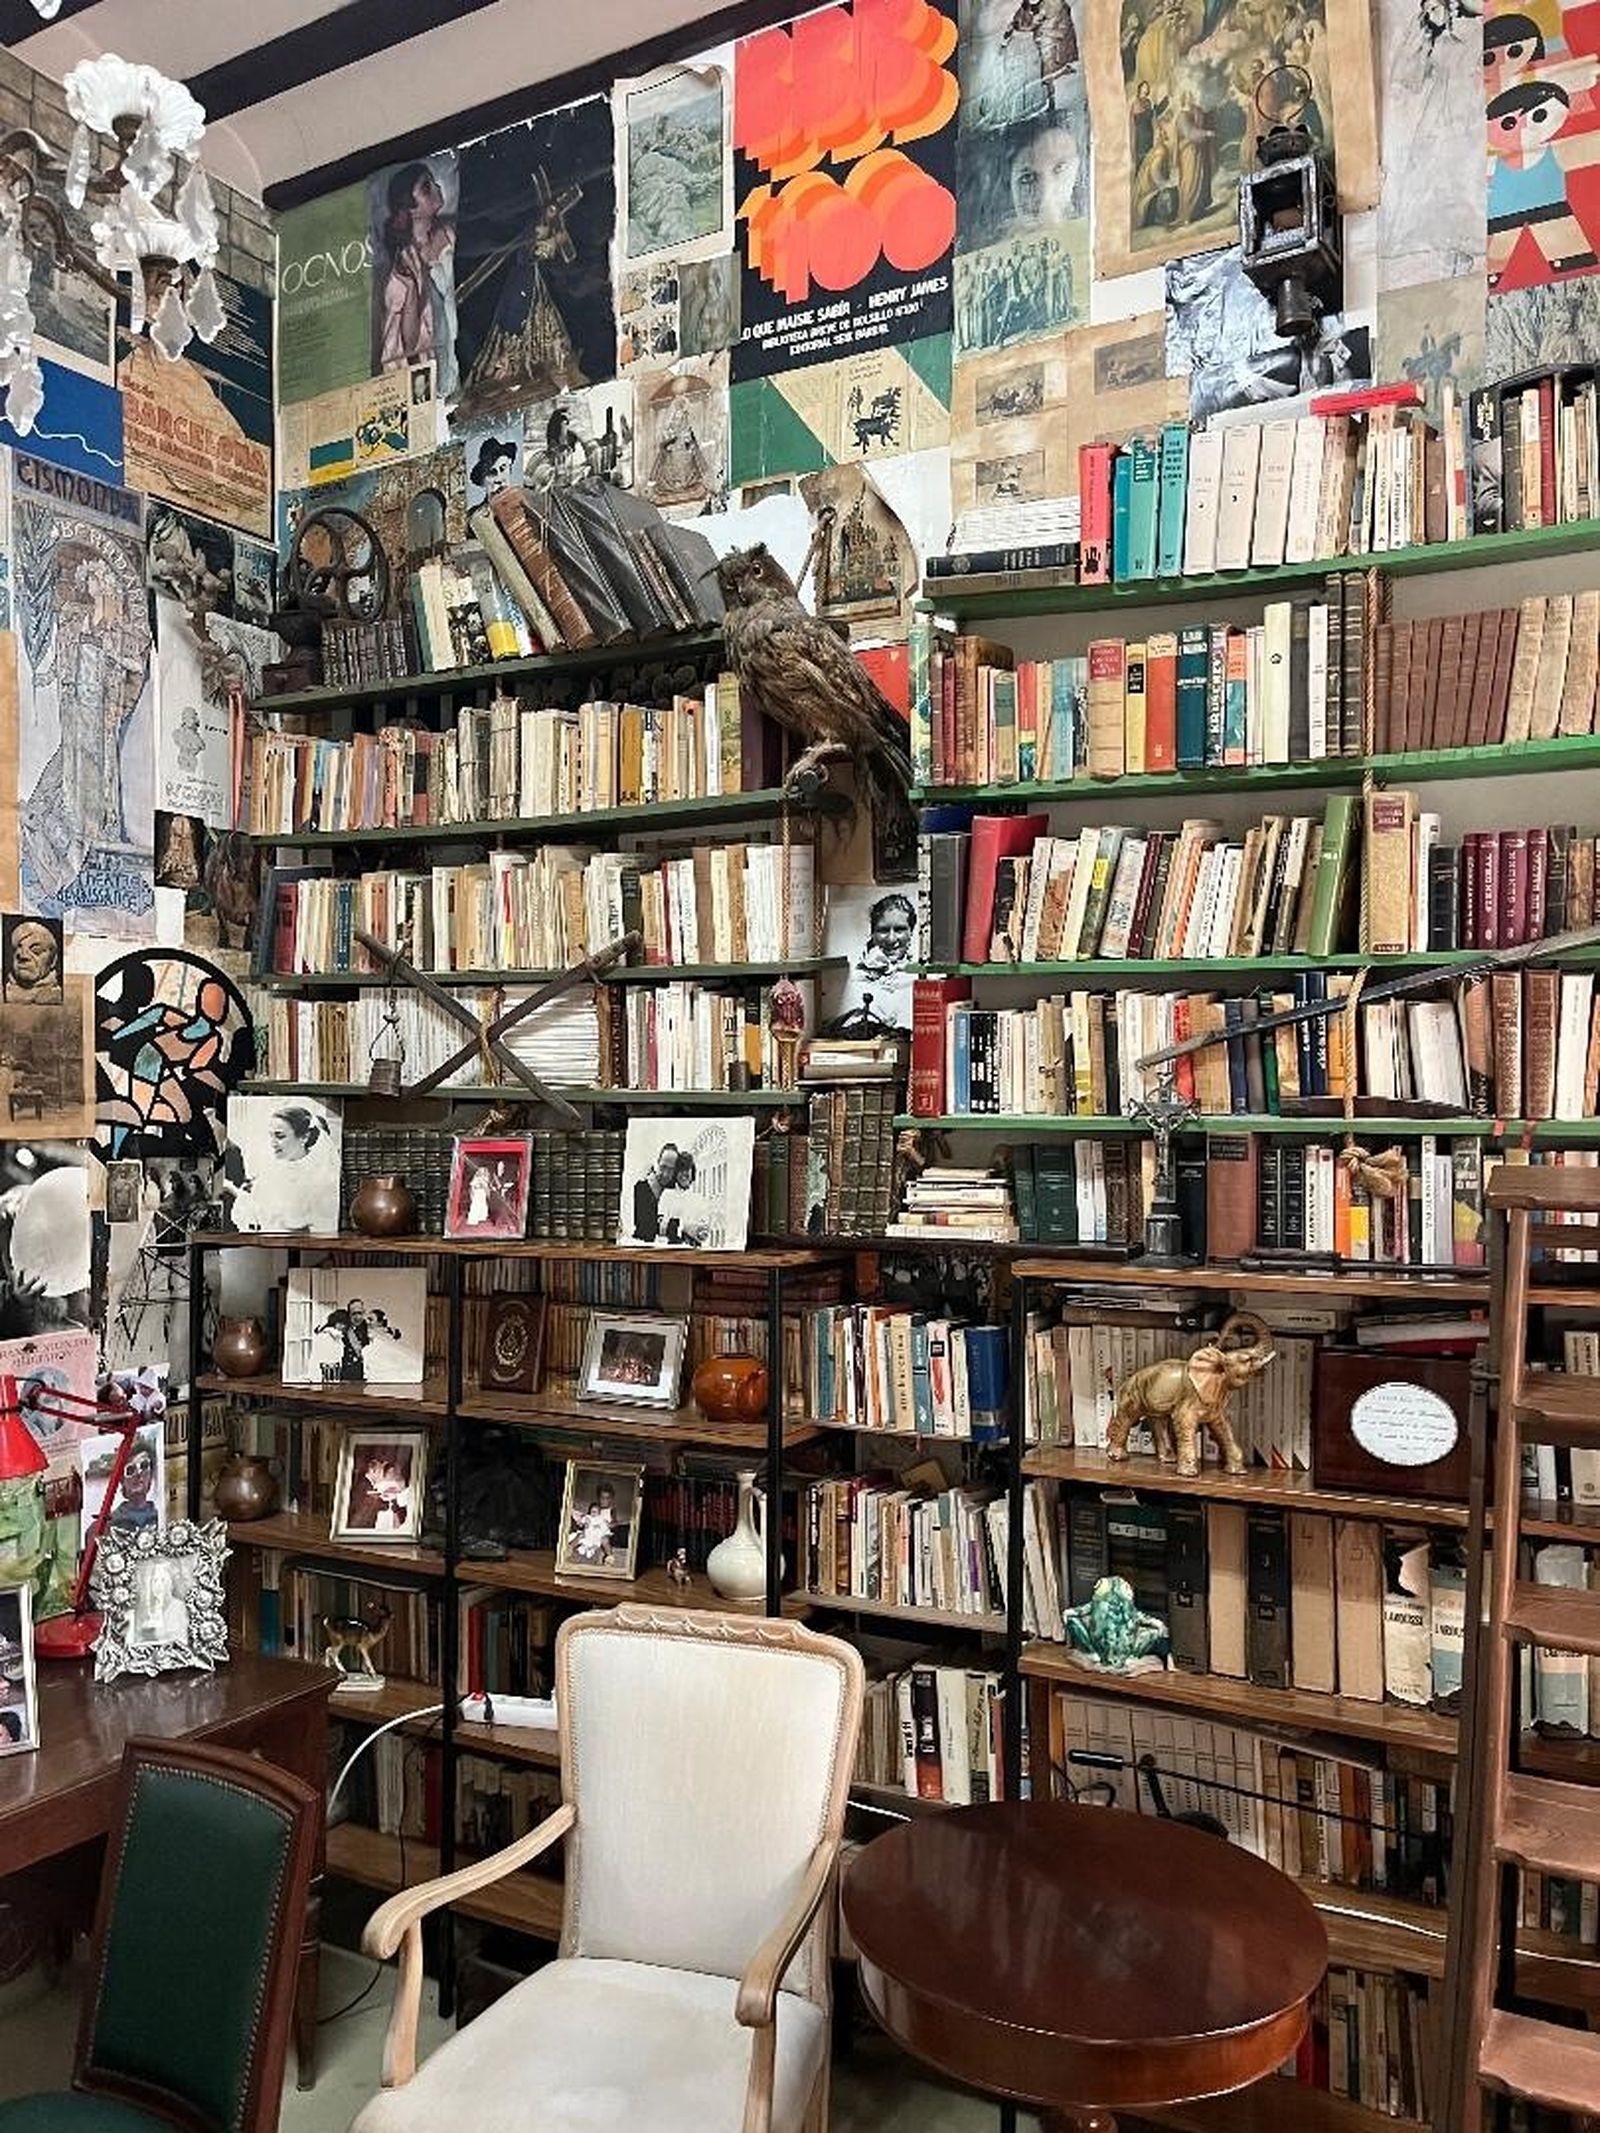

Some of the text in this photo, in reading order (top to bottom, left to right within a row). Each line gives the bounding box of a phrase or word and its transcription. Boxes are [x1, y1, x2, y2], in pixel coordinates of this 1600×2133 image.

[281, 234, 374, 295] OCNOS
[752, 321, 775, 339] QUE
[868, 285, 907, 309] HENRY
[909, 275, 950, 300] JAMES
